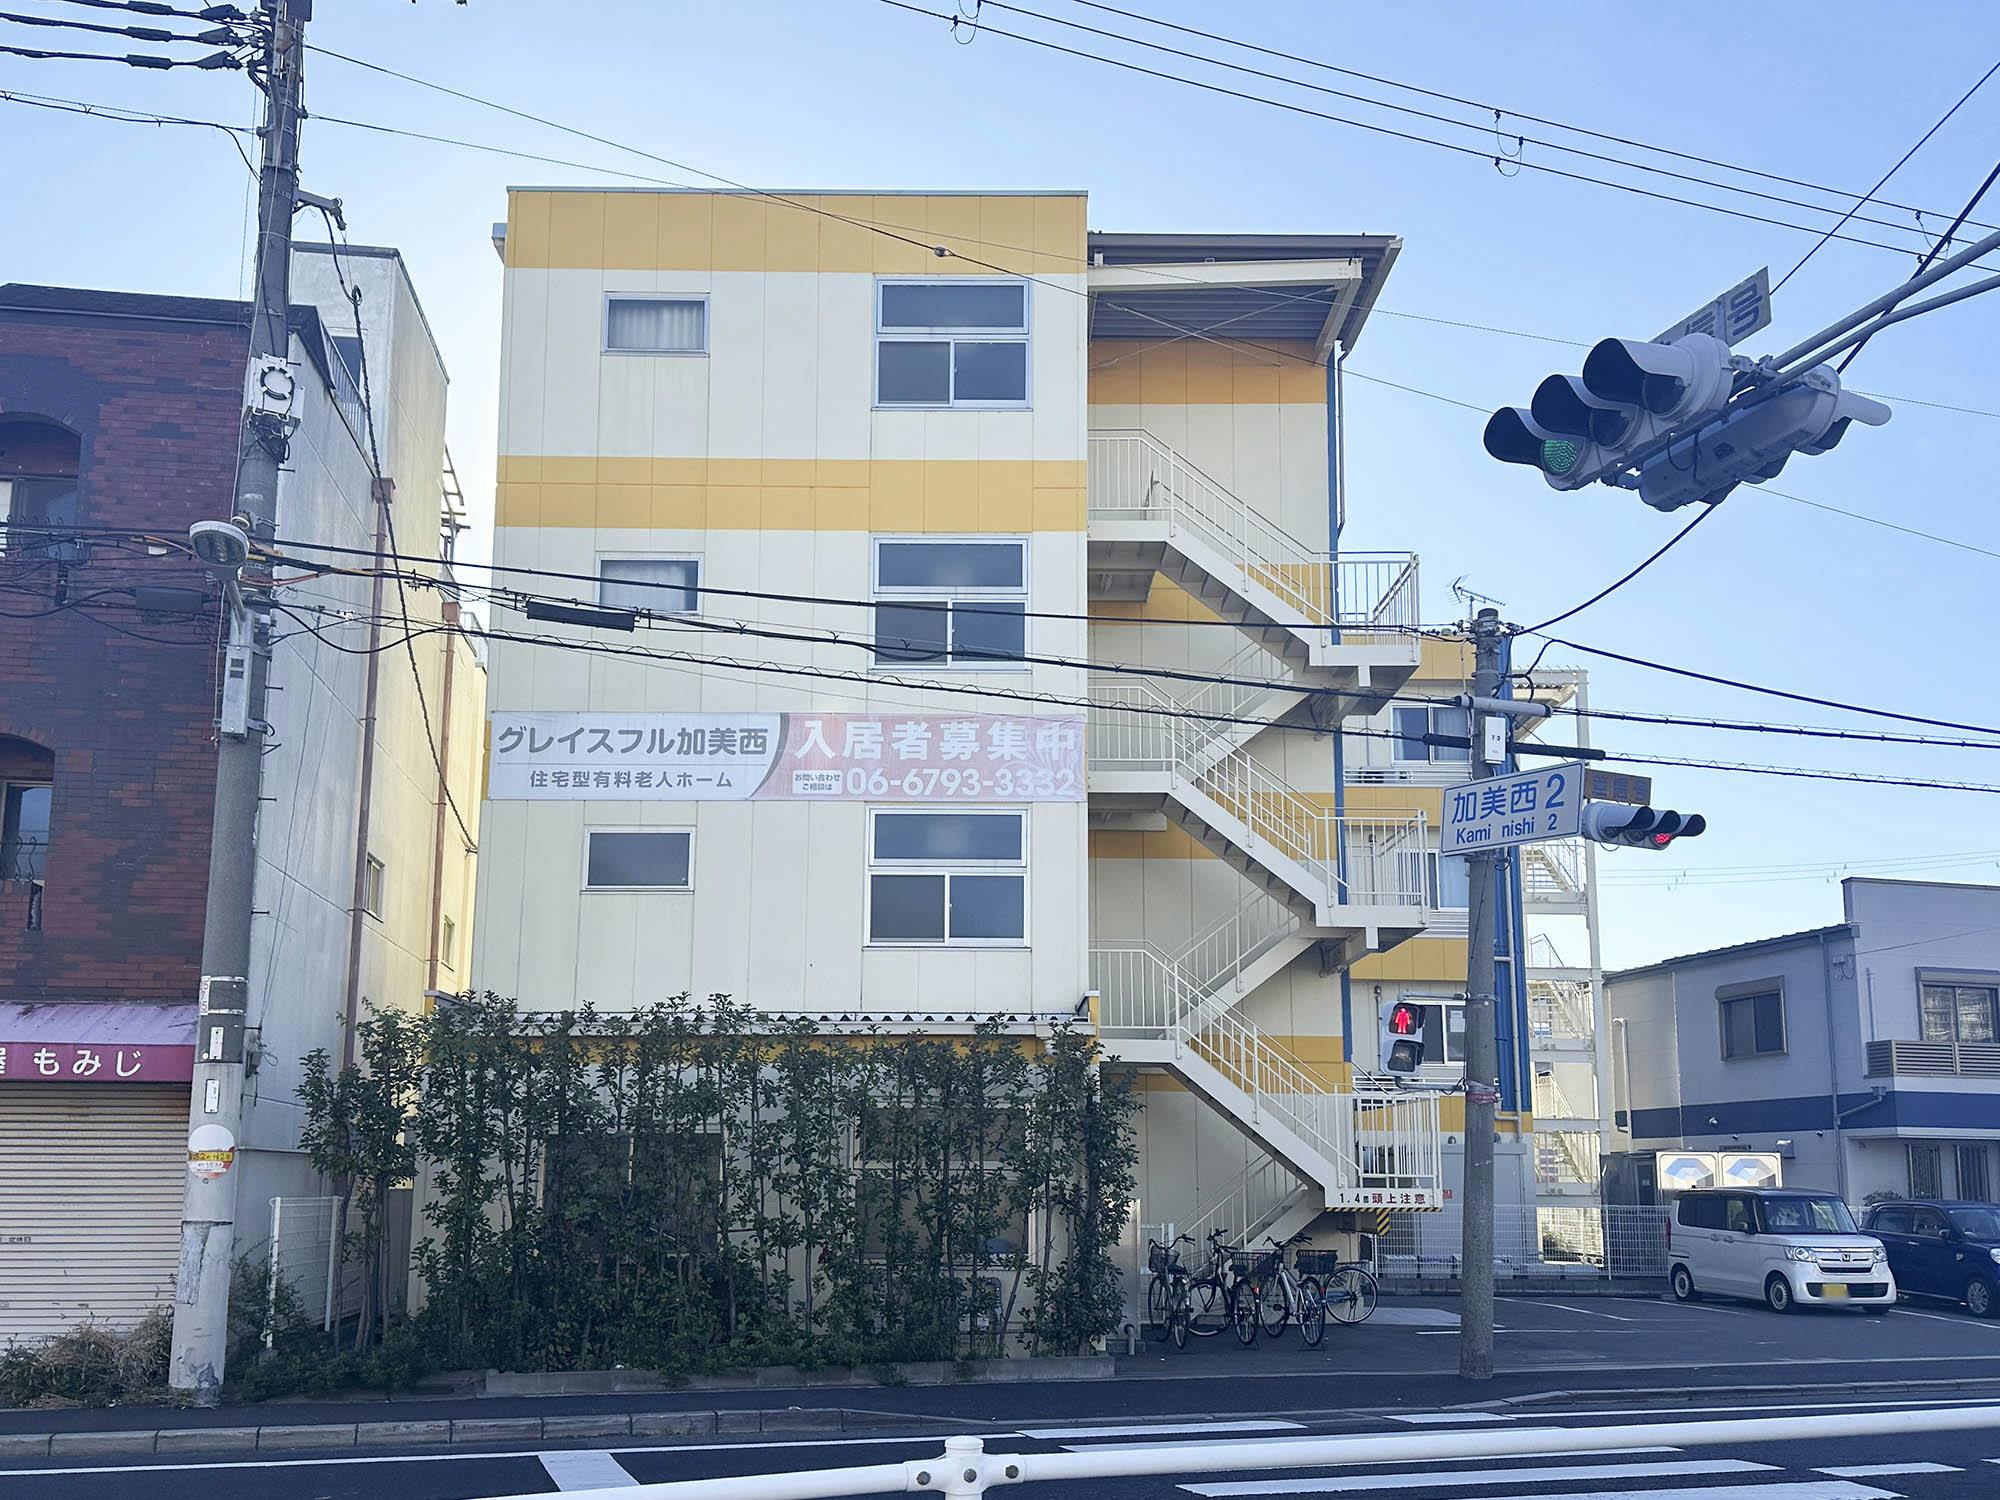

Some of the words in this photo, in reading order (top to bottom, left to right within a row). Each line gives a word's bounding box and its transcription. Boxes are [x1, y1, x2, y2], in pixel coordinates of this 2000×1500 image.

[498, 726, 769, 756] グレイスフル加美西
[794, 721, 1075, 760] 入居者募集中
[530, 770, 733, 789] 住宅型有料老人ホーム
[795, 773, 841, 782] お問い合わせ
[802, 783, 833, 791] ご相談は
[847, 770, 1075, 796] 06-6793-3332
[1456, 825, 1491, 845] Kami
[1502, 818, 1535, 840] nishi
[1548, 814, 1557, 831] 2
[33, 1047, 141, 1077] もみじ
